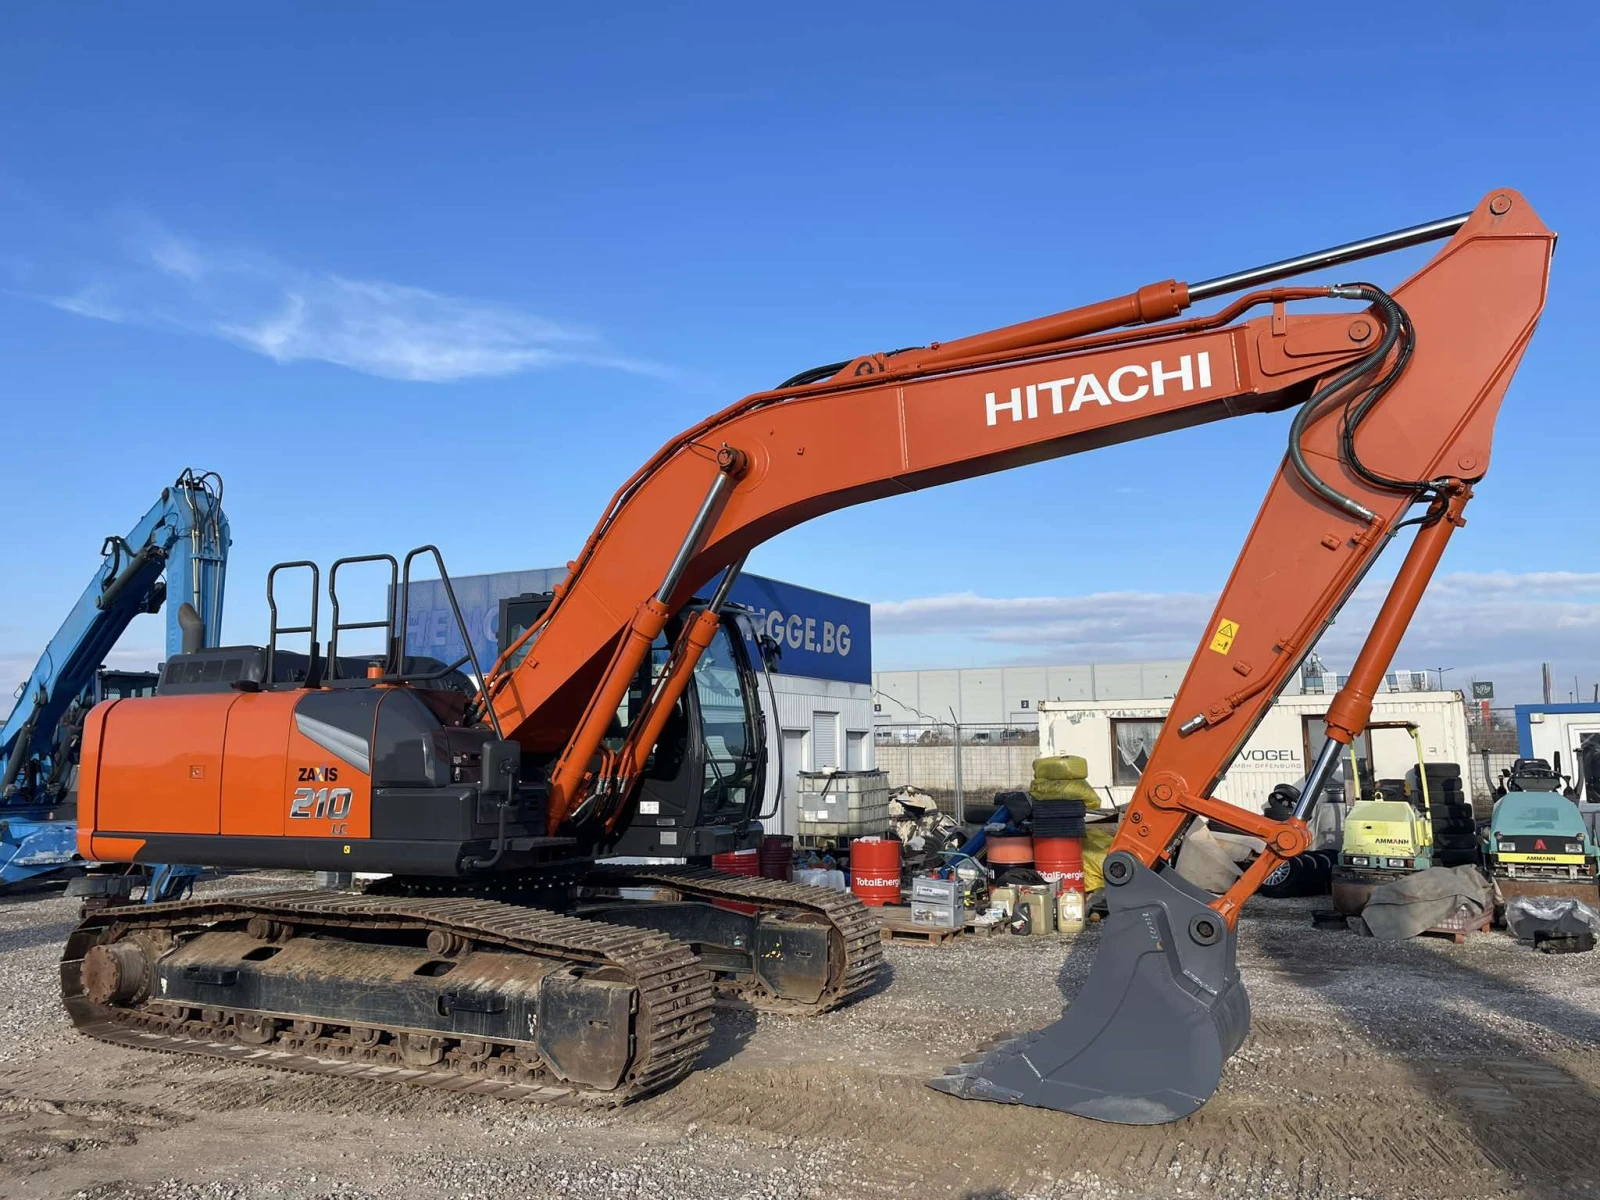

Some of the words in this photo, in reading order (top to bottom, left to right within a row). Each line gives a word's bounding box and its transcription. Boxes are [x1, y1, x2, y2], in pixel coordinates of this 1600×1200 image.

[985, 351, 1212, 426] HITACHI
[1240, 750, 1300, 760] VOGEL
[298, 765, 338, 782] ZAXIS
[290, 787, 353, 819] 210
[331, 823, 348, 835] LC
